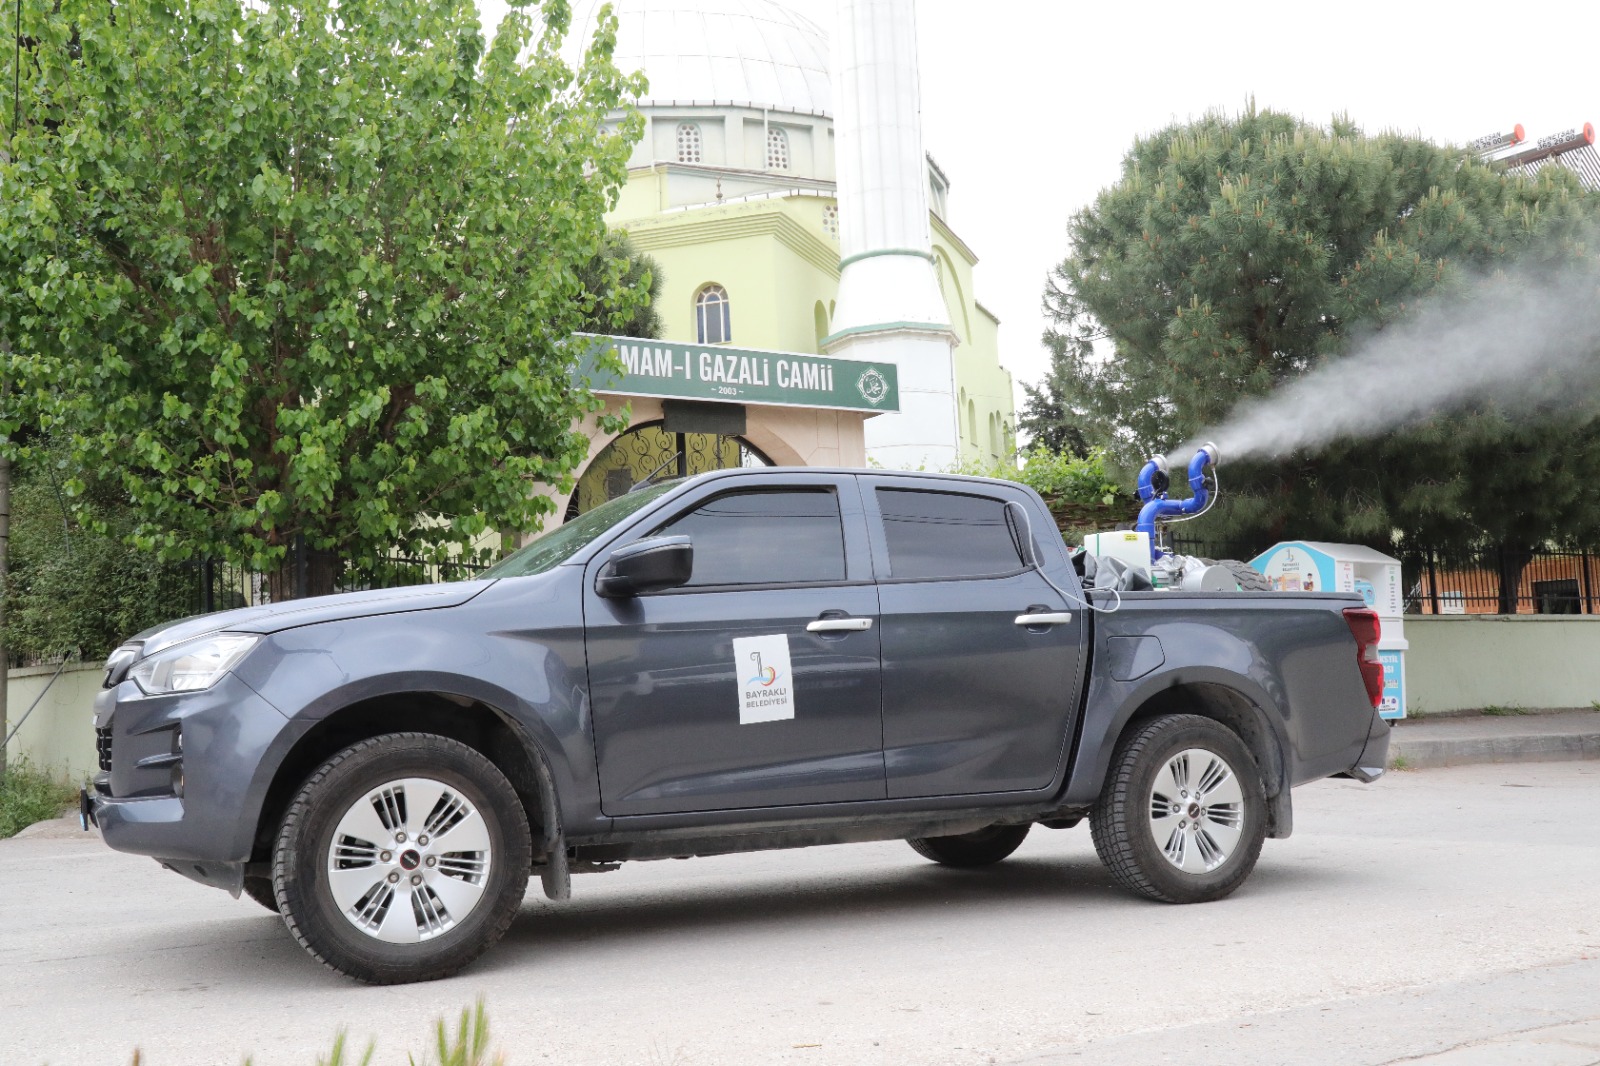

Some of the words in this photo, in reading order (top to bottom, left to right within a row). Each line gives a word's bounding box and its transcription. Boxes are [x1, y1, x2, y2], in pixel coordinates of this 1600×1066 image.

[613, 344, 691, 380] MAM-I
[718, 386, 737, 395] 2003
[746, 688, 787, 699] BAYRAKLI
[746, 697, 788, 708] BELEDİYESİ
